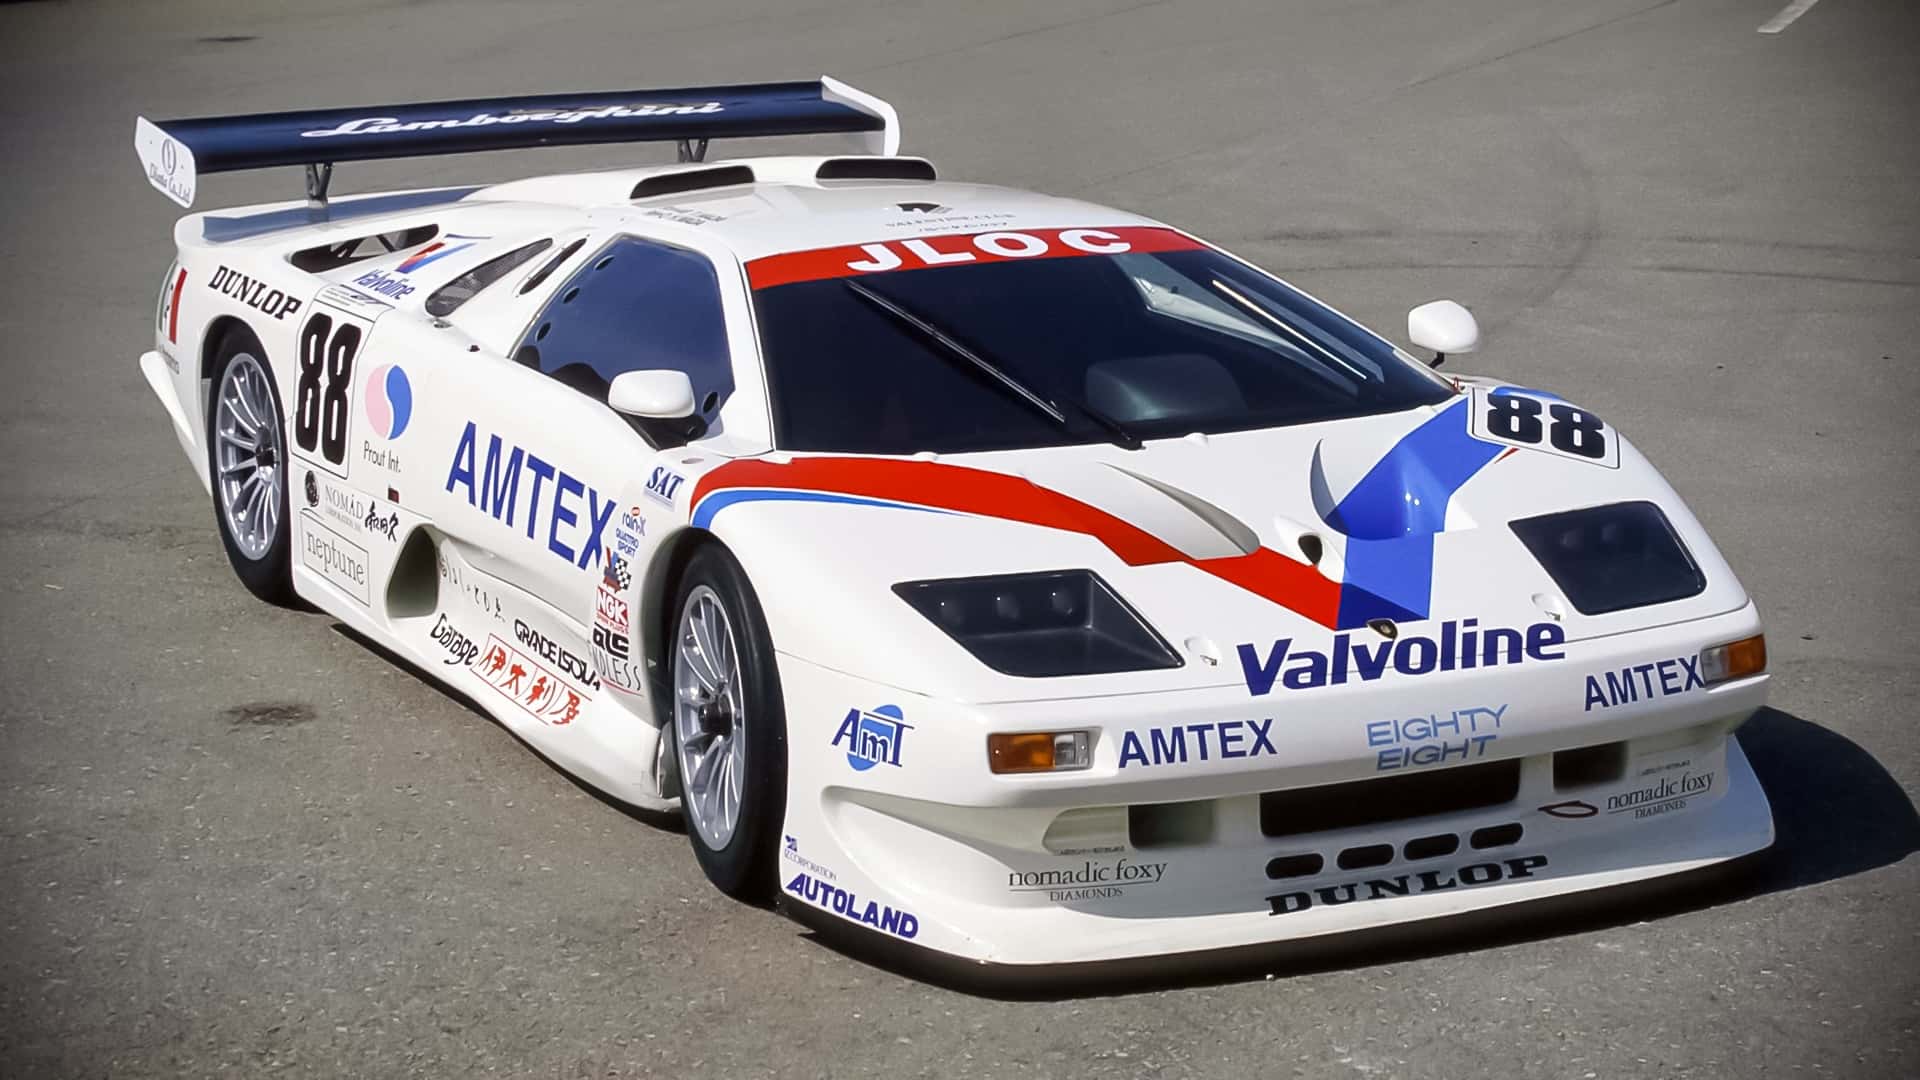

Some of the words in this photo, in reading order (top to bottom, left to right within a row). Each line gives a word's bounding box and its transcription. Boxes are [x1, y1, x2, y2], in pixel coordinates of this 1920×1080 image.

[301, 102, 725, 138] Lamborghini
[847, 229, 1132, 272] JLOC
[208, 265, 302, 320] DUNLOP
[352, 269, 415, 300] Valvoline
[296, 312, 361, 466] 88
[1487, 393, 1605, 459] 88
[364, 440, 386, 468] Prout
[445, 420, 617, 571] AMTEX
[646, 466, 685, 500] SAT
[306, 532, 365, 586] neptune
[597, 589, 629, 626] NGK
[430, 613, 478, 665] Garage
[1237, 617, 1566, 696] Valvoline
[1585, 654, 1705, 711] AMTEX
[1118, 718, 1278, 769] AMTEX
[1366, 703, 1508, 747] EIGHTY
[1377, 735, 1497, 771] EIGHT
[1607, 778, 1678, 810] nomadic
[1681, 772, 1715, 794] foxy
[1635, 799, 1686, 820] DIAMONDS
[1009, 861, 1110, 886] nomadic
[1116, 859, 1168, 883] foxy
[1050, 886, 1124, 901] DIAMONDS
[1265, 854, 1548, 917] DUNLOP
[786, 872, 918, 939] AUTOLAND
